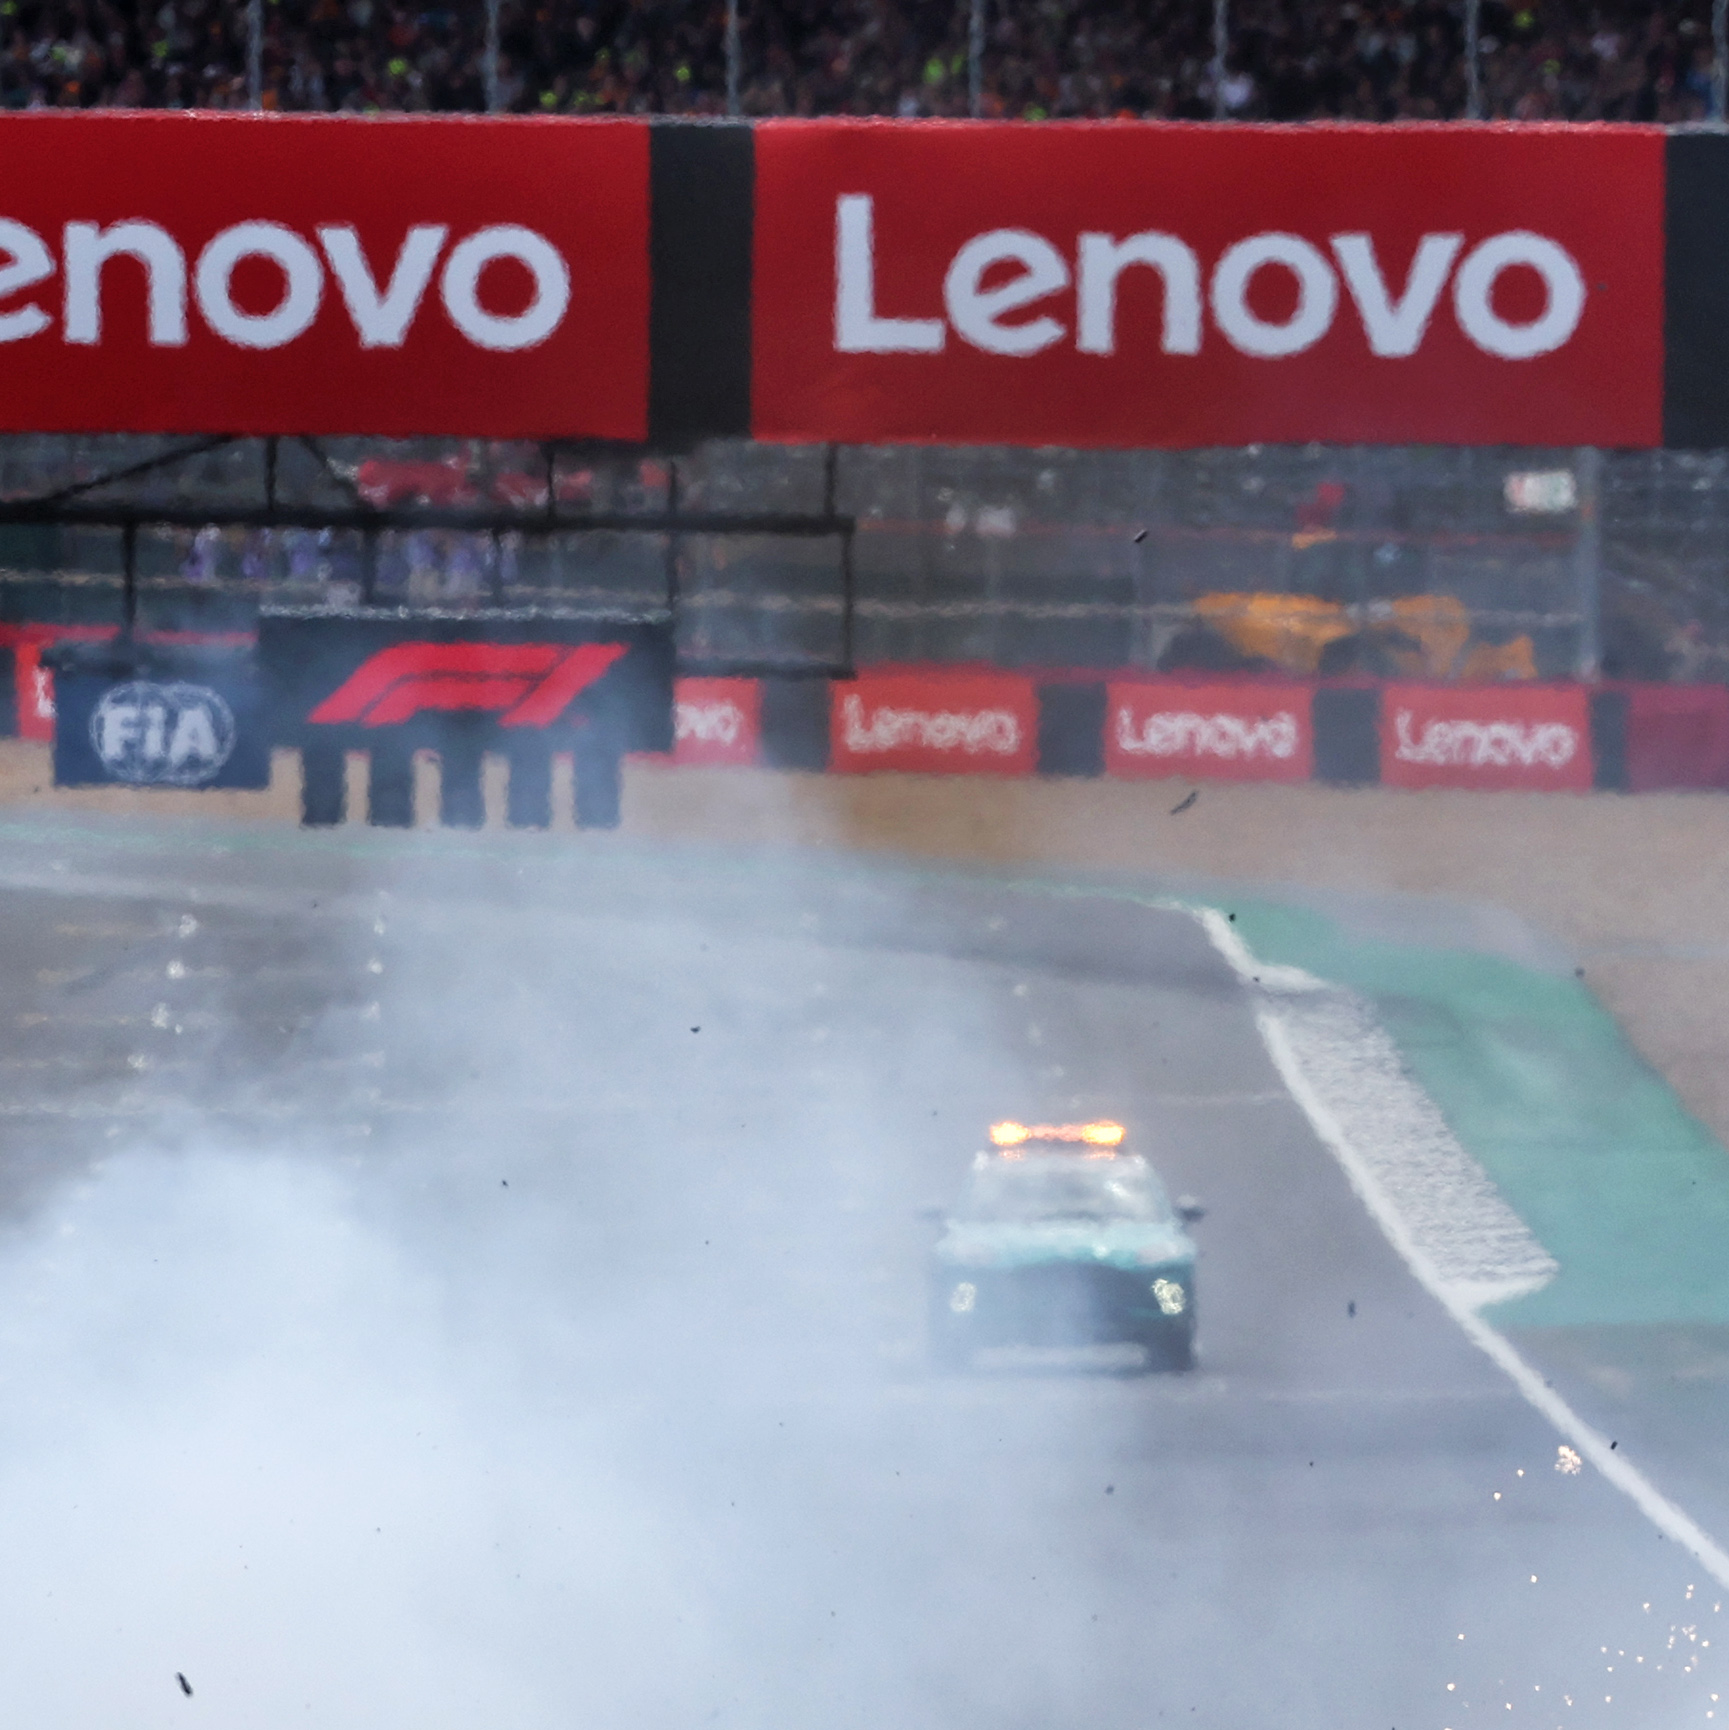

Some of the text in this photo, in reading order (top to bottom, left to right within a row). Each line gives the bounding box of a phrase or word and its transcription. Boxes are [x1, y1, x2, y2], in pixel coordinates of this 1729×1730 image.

[832, 192, 1588, 361] Lenovo
[103, 703, 219, 764] FIA
[843, 693, 1020, 755] Lenovo
[1117, 706, 1299, 759] Lenovo
[1394, 709, 1579, 769] Lenovo
